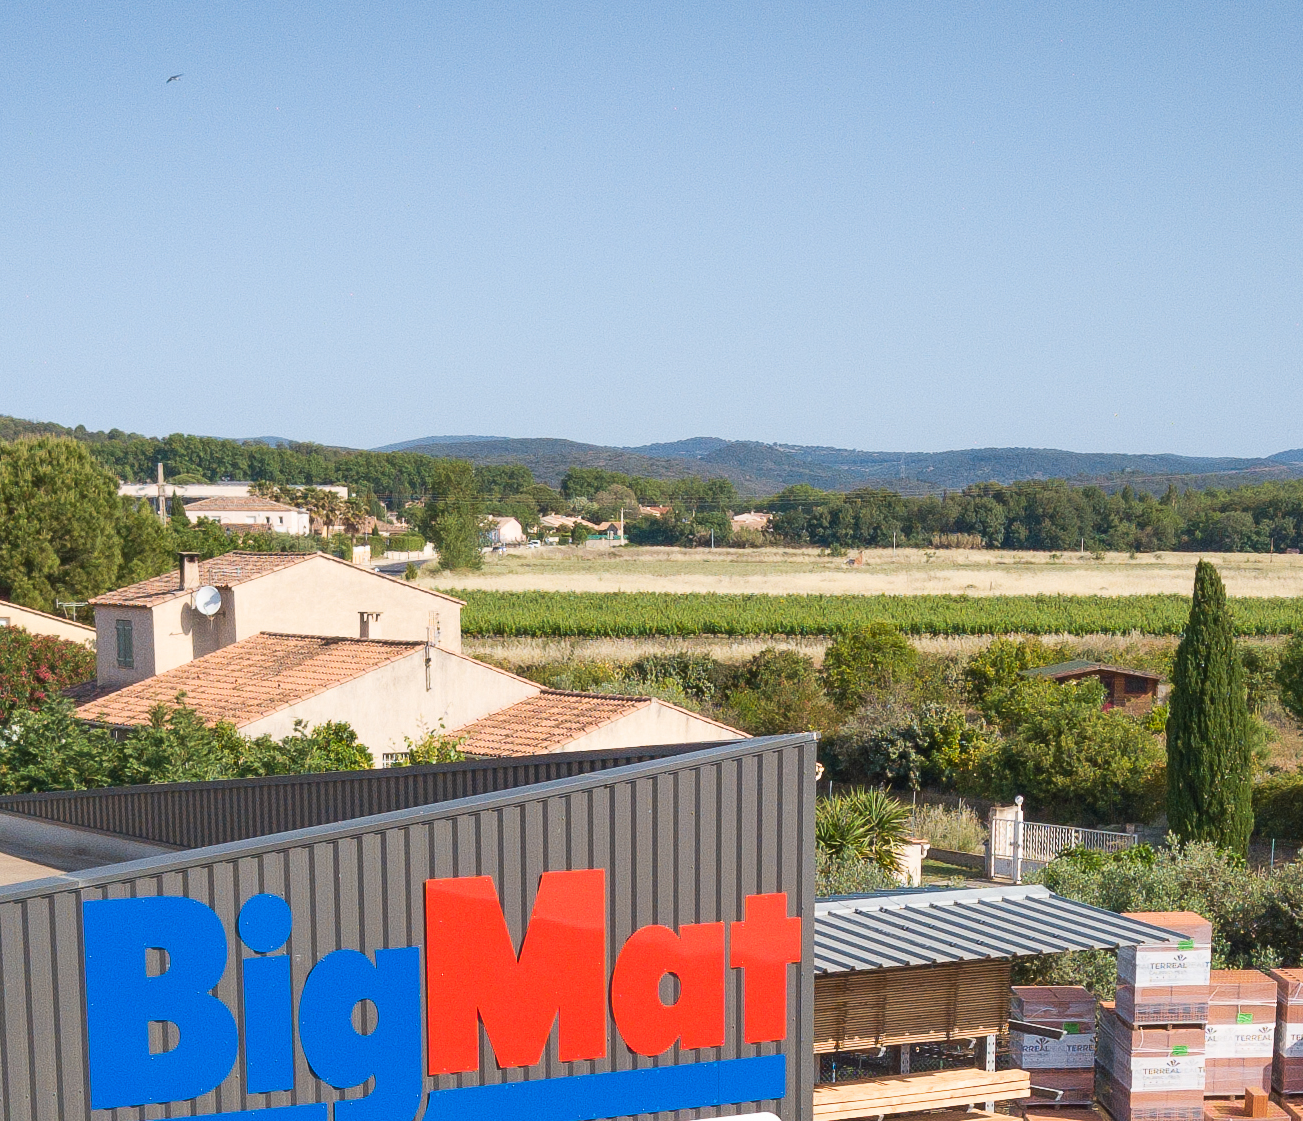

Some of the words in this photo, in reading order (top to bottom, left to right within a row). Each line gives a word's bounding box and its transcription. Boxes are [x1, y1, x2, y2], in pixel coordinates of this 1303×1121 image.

[1150, 962, 1188, 970] TERREAL
[1235, 1034, 1273, 1042] TERREAL
[1143, 1067, 1181, 1075] TERREAL
